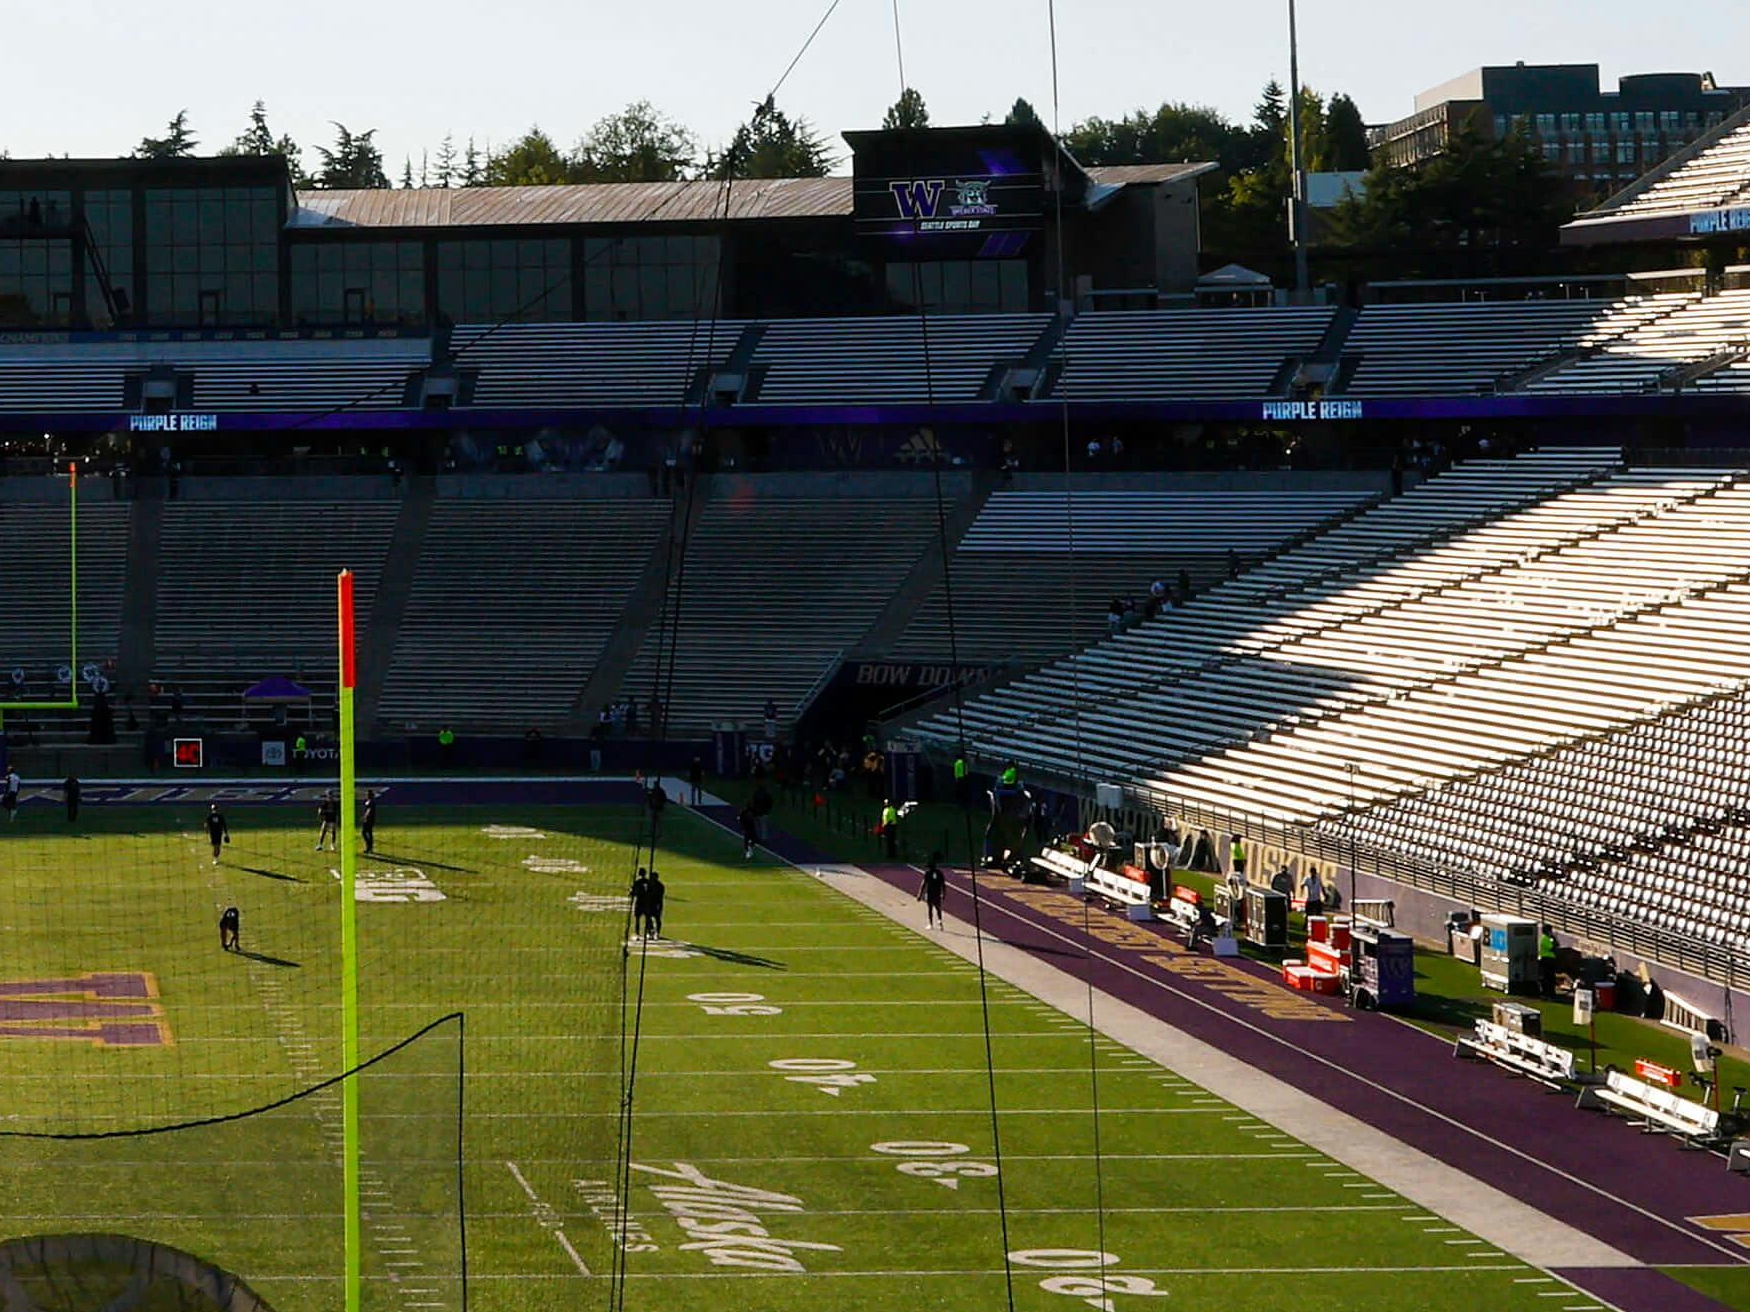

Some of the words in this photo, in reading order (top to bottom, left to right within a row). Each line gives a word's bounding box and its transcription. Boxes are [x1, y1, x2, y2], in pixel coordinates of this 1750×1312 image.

[889, 180, 945, 220] W
[1690, 210, 1729, 234] PURPLE
[130, 414, 178, 431] PURPLE
[180, 414, 217, 431] REIGN
[1262, 401, 1317, 420] PURPLE
[1320, 400, 1363, 419] REIGN
[855, 663, 911, 685] BOW
[686, 991, 783, 1017] 50
[768, 1058, 877, 1089] 40
[869, 1140, 998, 1179] 30
[627, 1161, 843, 1273] Alaska
[1006, 1248, 1168, 1300] 20
